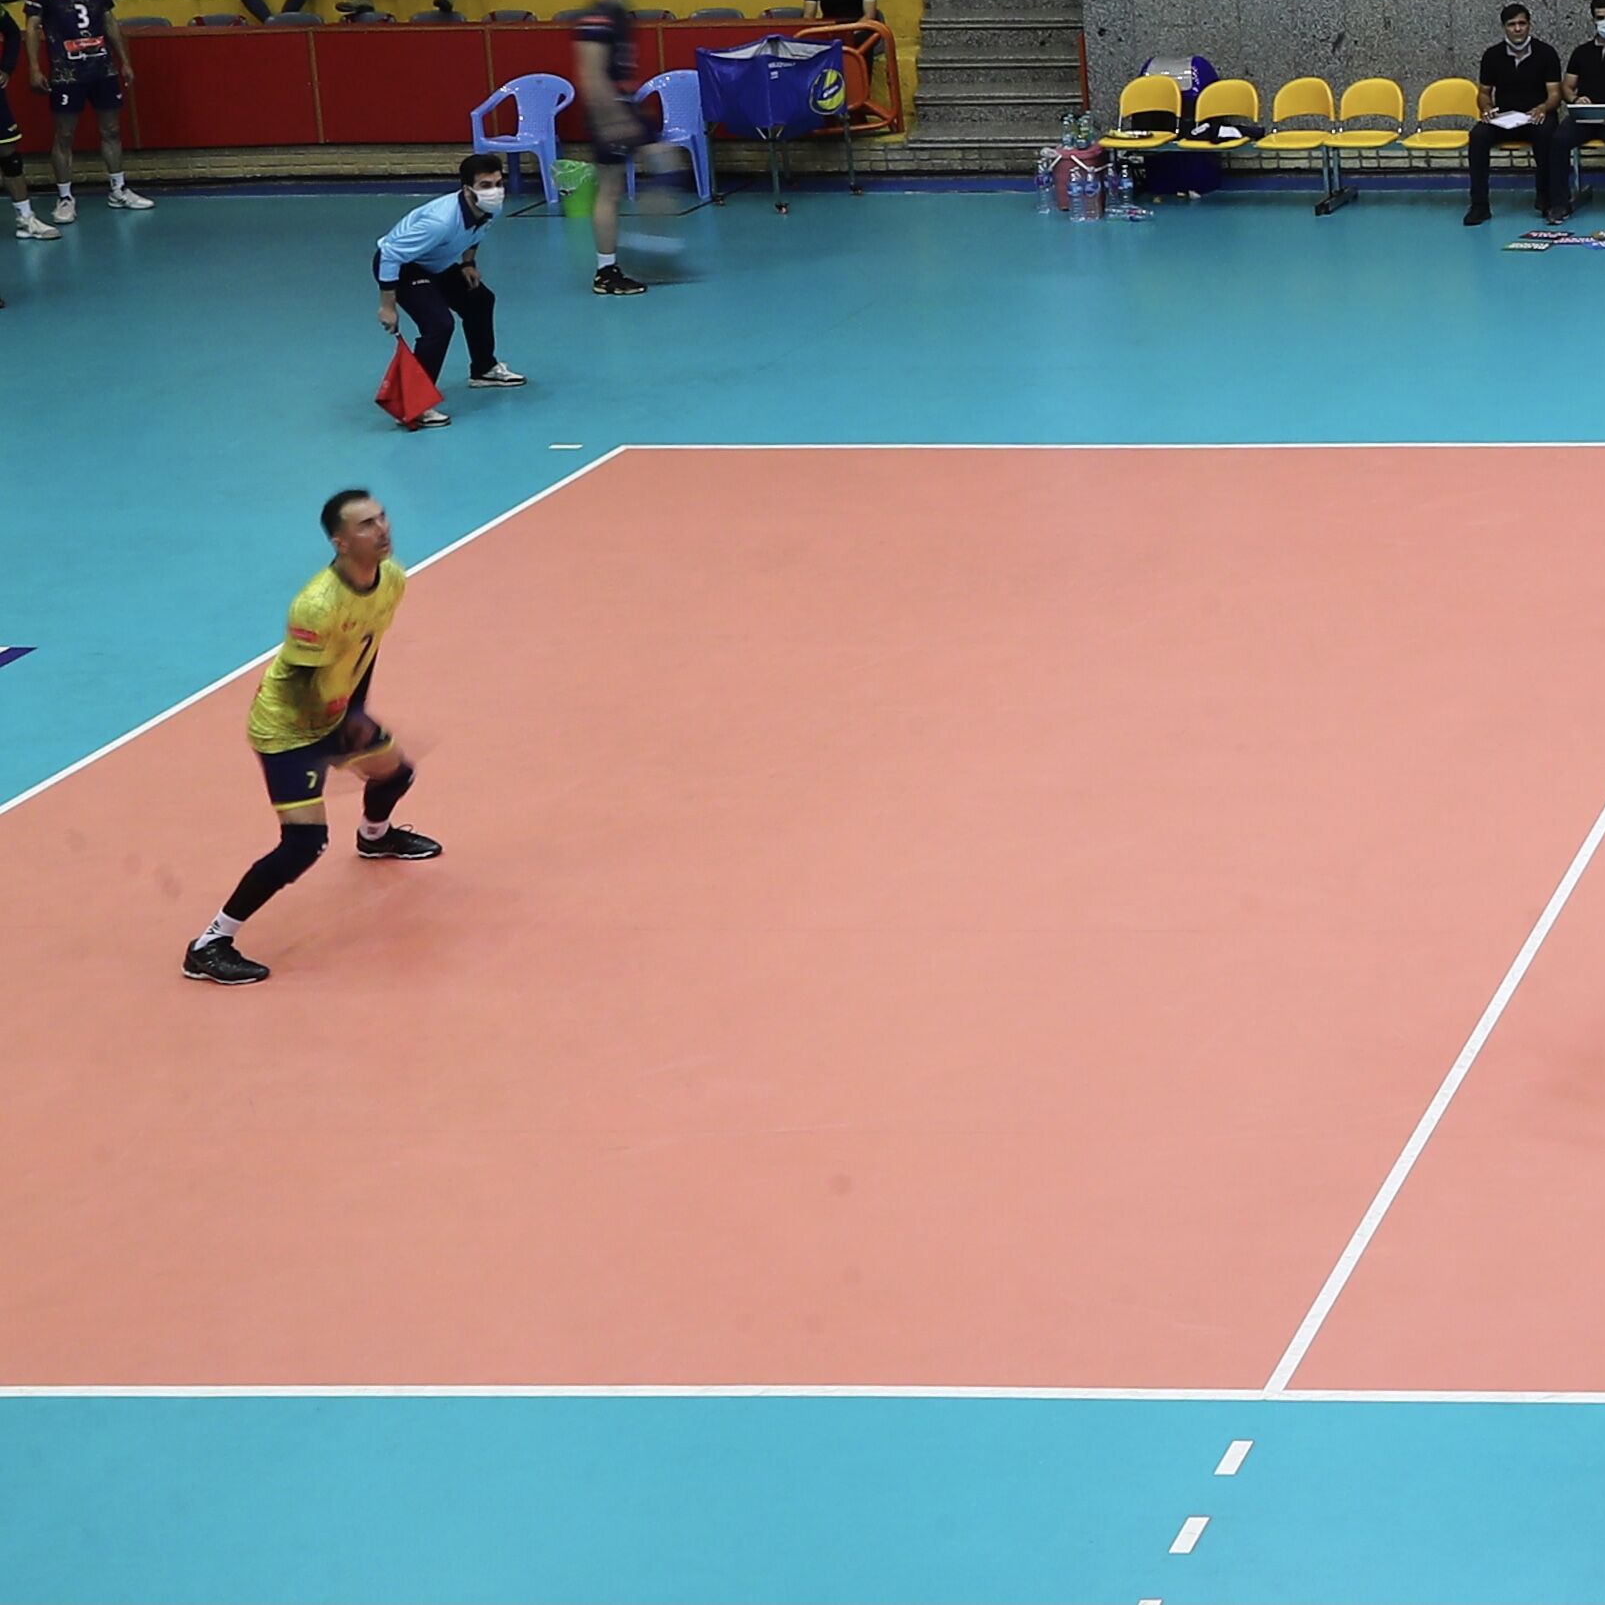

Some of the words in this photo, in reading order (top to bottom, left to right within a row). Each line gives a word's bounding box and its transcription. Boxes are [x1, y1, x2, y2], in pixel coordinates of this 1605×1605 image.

[74, 3, 91, 29] 3
[61, 94, 69, 106] 3
[306, 770, 318, 789] 7
